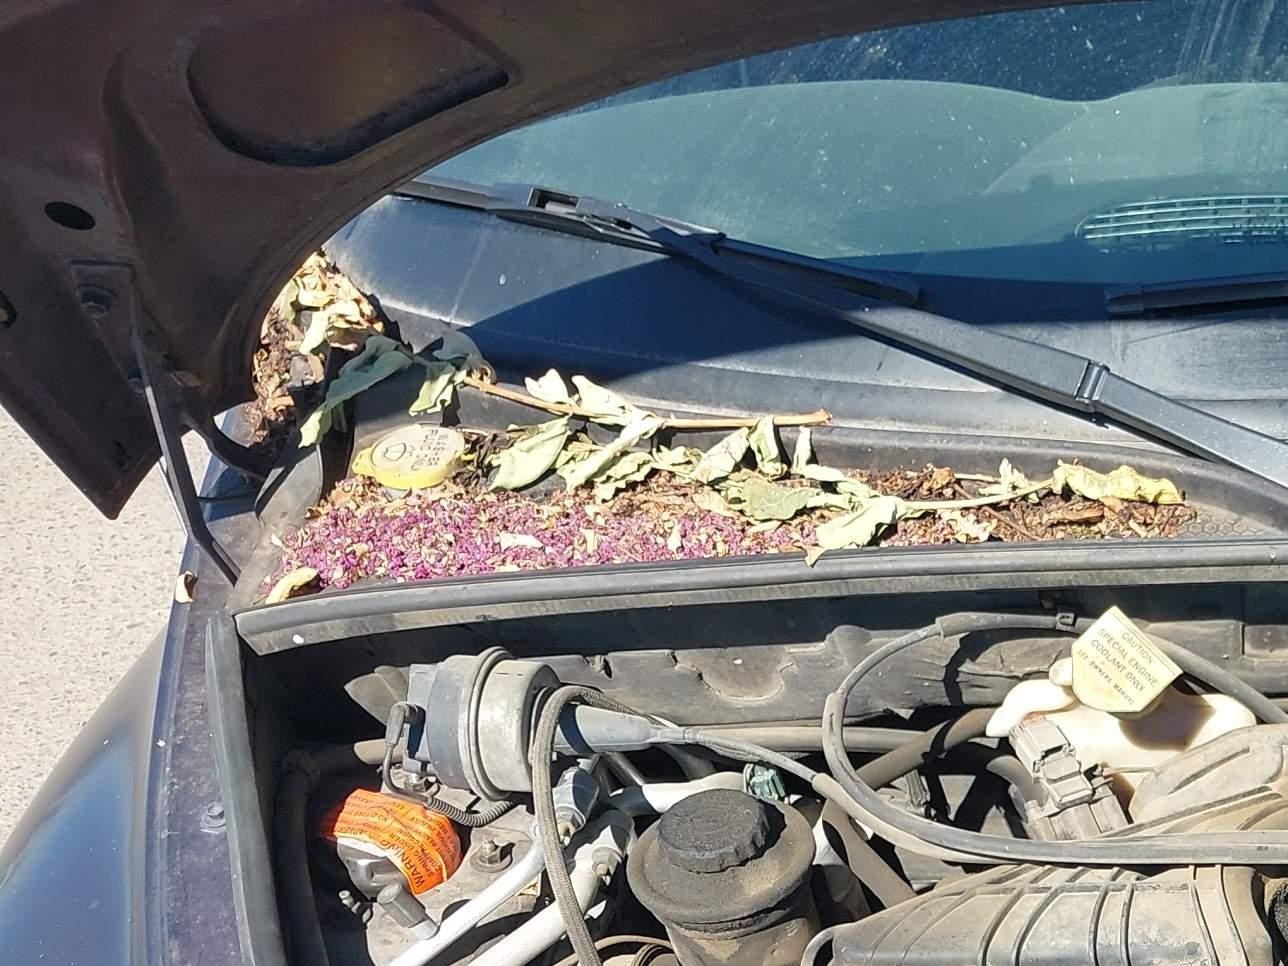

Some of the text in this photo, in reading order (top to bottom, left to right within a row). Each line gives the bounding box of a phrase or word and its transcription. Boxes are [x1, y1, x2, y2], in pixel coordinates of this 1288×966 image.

[1091, 639, 1148, 692] COOLANT ONLY
[1098, 628, 1159, 688] SPECIAL ENGINE
[1121, 632, 1152, 663] CAUTION
[379, 838, 425, 888] WARNING
[413, 848, 434, 878] SPRING
